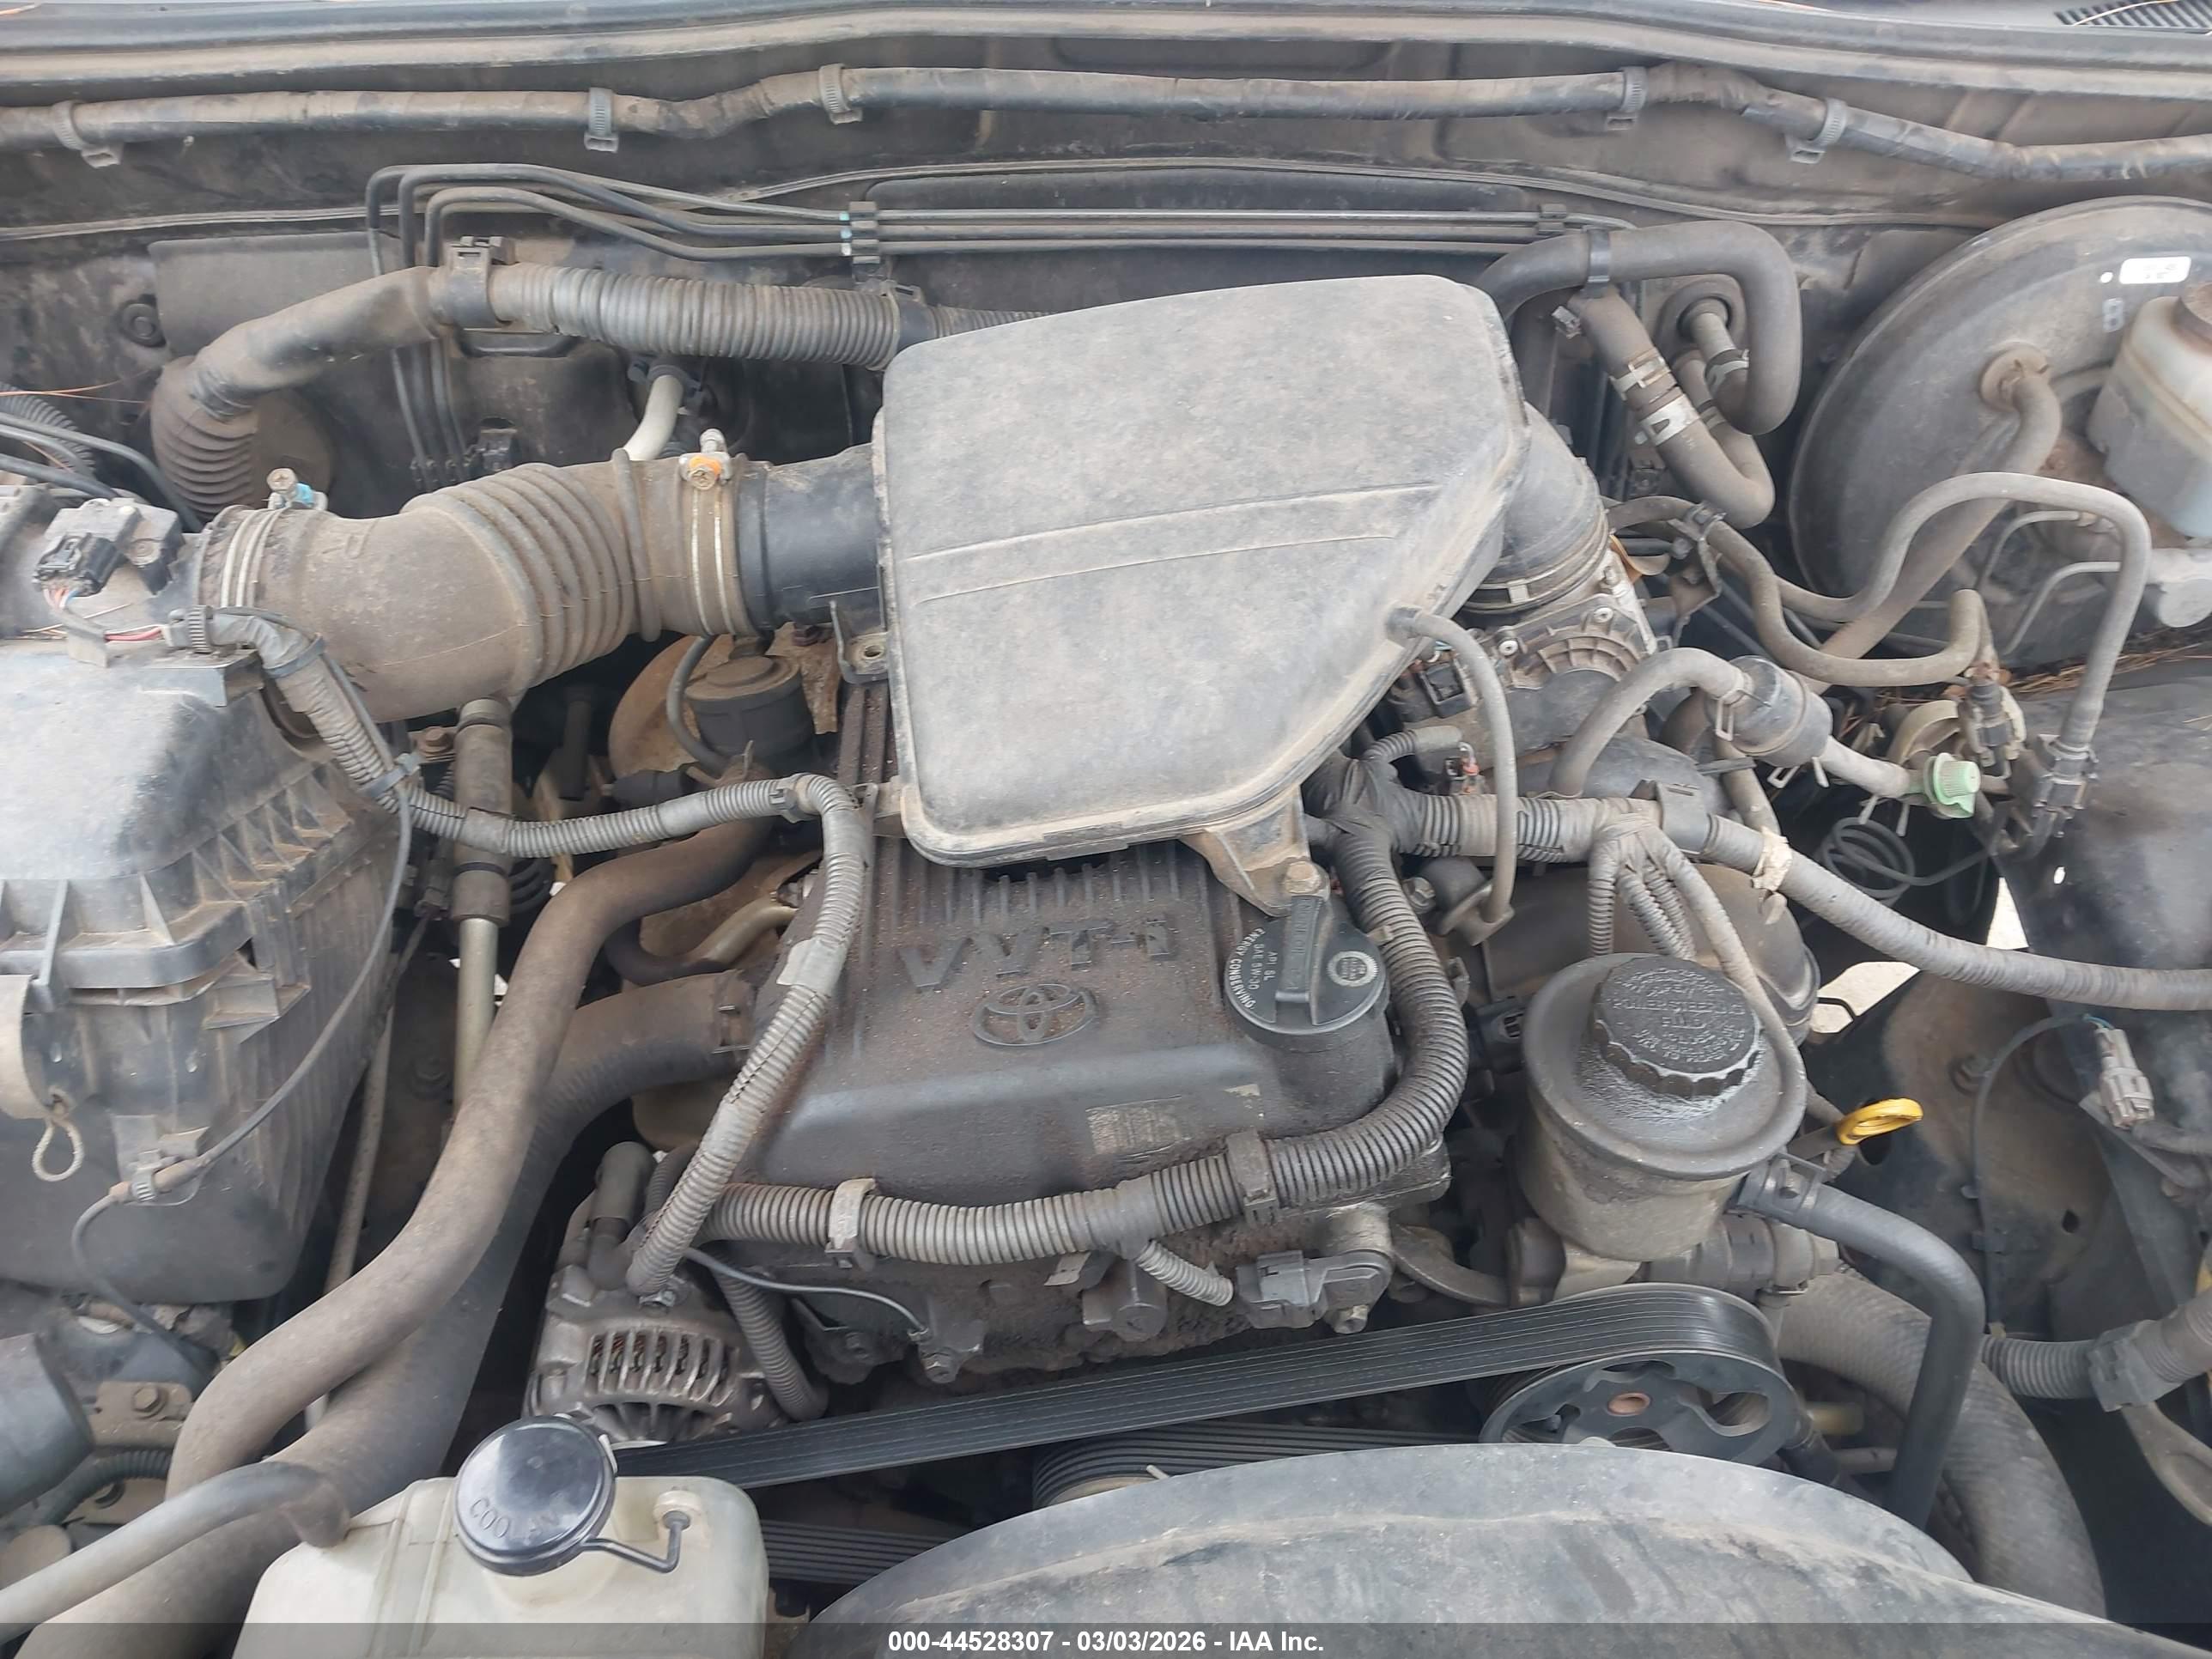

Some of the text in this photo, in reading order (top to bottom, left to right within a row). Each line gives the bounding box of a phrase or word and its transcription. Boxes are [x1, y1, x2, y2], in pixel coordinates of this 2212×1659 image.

[1251, 944, 1265, 956] SAE
[1266, 951, 1278, 965] API
[1229, 927, 1266, 1009] ENERGY CONSERVING
